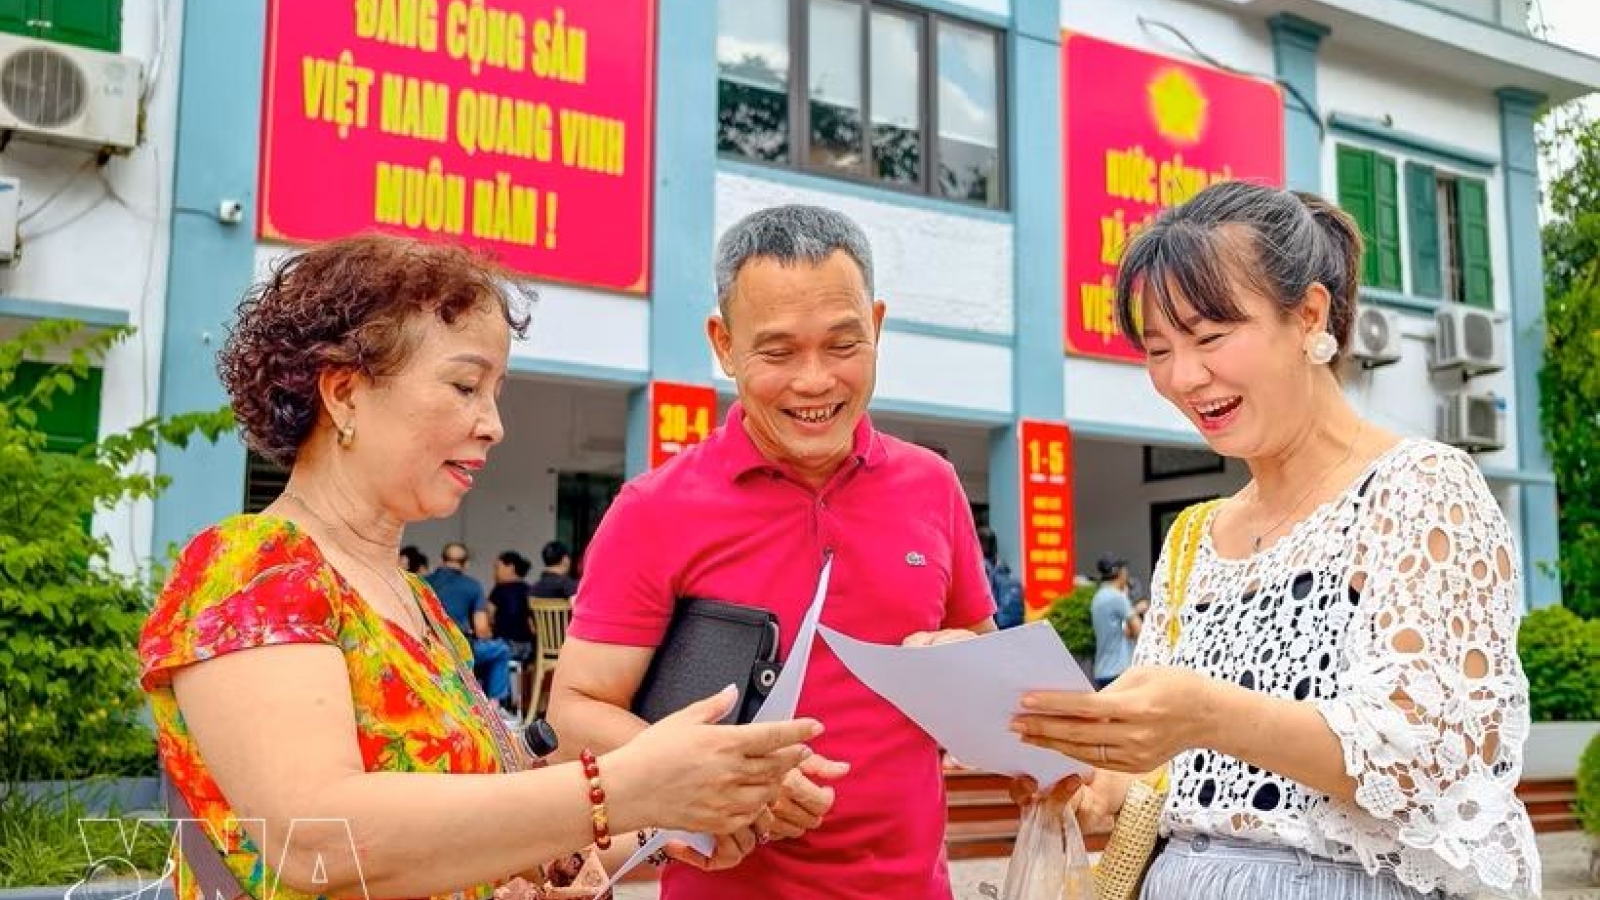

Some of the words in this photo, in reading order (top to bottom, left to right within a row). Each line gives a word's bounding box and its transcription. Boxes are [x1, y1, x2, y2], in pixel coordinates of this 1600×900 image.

[446, 0, 525, 76] CỘNG
[532, 7, 587, 84] SẢN
[302, 50, 374, 139] VIỆT
[380, 73, 449, 142] NAM
[456, 87, 553, 162] QUANG
[560, 109, 625, 176] VINH
[375, 157, 466, 235] MUÔN
[473, 171, 538, 246] NĂM
[545, 192, 557, 249] !
[1029, 440, 1064, 474] 1-5
